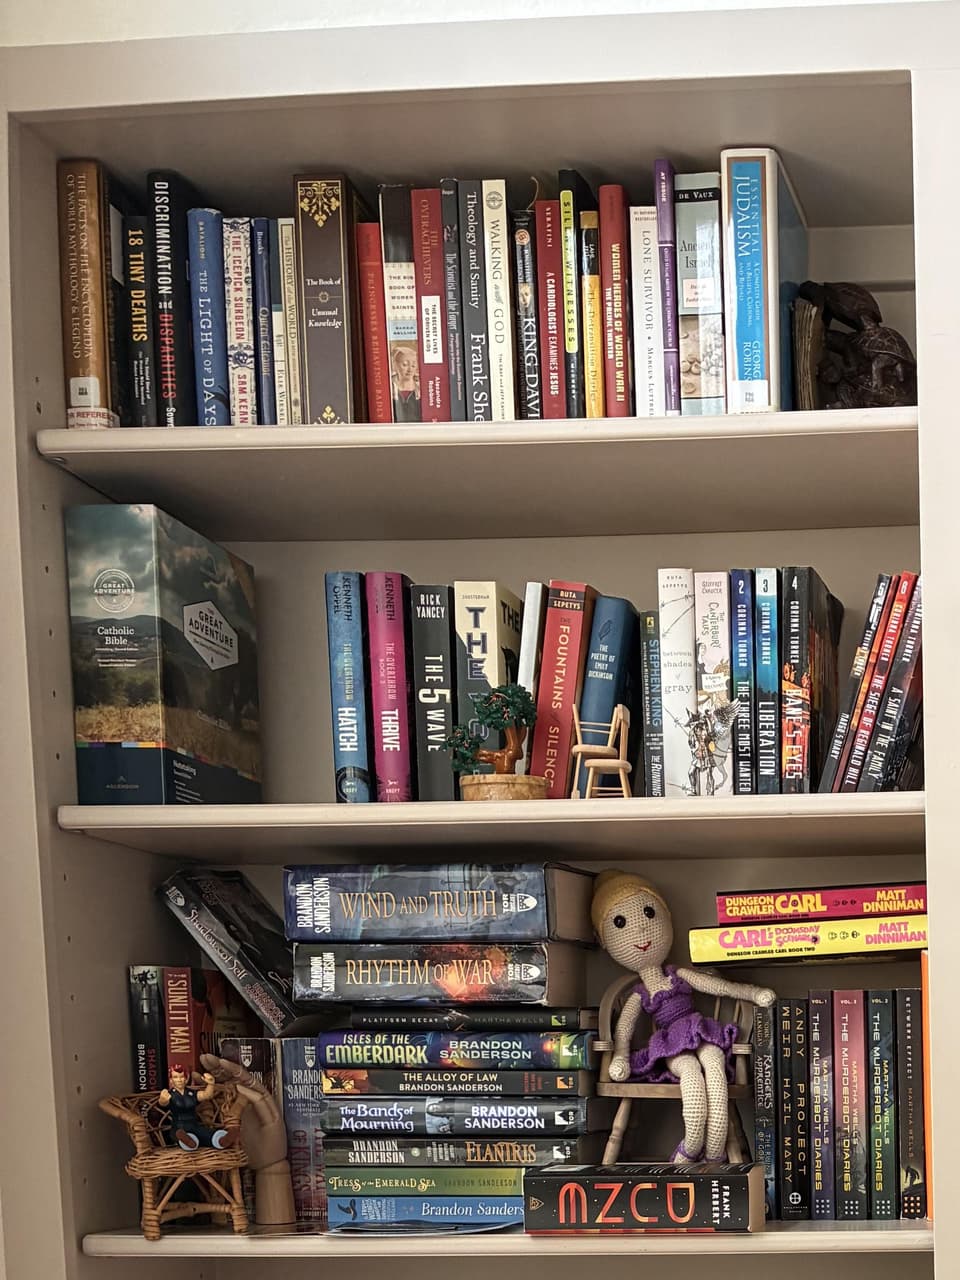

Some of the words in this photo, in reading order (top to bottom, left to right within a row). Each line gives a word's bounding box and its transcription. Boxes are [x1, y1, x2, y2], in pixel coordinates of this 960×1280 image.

[467, 192, 476, 245] Theology
[735, 176, 750, 257] JUDAISM
[129, 230, 143, 246] 18
[154, 181, 172, 294] DISCRIMINATION
[490, 220, 501, 280] WALKING
[642, 231, 651, 262] LONE
[129, 252, 144, 283] TINY
[470, 249, 479, 264] and
[611, 244, 621, 280] WOMEN
[470, 266, 480, 308] Sanity
[613, 283, 622, 318] HEROES
[645, 269, 654, 330] SURVIVOR
[130, 290, 148, 342] DEATHS
[199, 298, 212, 356] LIGHT
[494, 309, 504, 343] GOD
[614, 321, 623, 332] OF
[159, 314, 176, 399] DISPARITIES
[615, 335, 623, 368] WORLD
[204, 360, 212, 374] OF
[616, 370, 624, 392] WAR
[203, 378, 217, 426] DAYS
[763, 580, 768, 592] 3
[792, 577, 798, 589] 4
[416, 606, 445, 618] YANCEY
[420, 594, 440, 605] RICK
[554, 601, 580, 609] SEPETYS
[97, 627, 134, 635] Catholic
[760, 603, 770, 636] CORINNA
[105, 637, 128, 645] Bible
[762, 640, 770, 664] TURNER
[552, 625, 570, 708] FOUNTAINS
[649, 640, 660, 695] STEPHEN
[652, 697, 662, 727] KING
[338, 708, 358, 752] HATCH
[381, 709, 400, 752] THRIVE
[759, 702, 775, 775] LIBERATION
[786, 744, 802, 778] EYES
[297, 884, 312, 928] BRANDON
[313, 877, 331, 933] SANDERSON
[338, 892, 396, 919] WIND
[400, 897, 428, 914] AND
[429, 890, 497, 918] TRUTH
[726, 896, 774, 906] DUNGEON
[726, 905, 774, 915] CRAWLER
[776, 893, 827, 913] CARL
[863, 899, 923, 913] DINNIMAN
[877, 890, 906, 900] MATT
[346, 960, 431, 985] RHYTHM
[434, 964, 449, 982] OF
[449, 960, 495, 984] WAR
[168, 979, 189, 1023] SUNLIT
[170, 1027, 190, 1053] MAN
[343, 1035, 372, 1044] ISLES
[375, 1034, 387, 1043] OF
[391, 1034, 410, 1043] THE
[449, 1041, 522, 1049] BRANDON
[326, 1045, 428, 1064] EMBERDARK
[440, 1050, 532, 1059] SANDERSON
[424, 1073, 457, 1081] ALLOY
[477, 1073, 498, 1081] LAW
[465, 1141, 536, 1162] ELANTRIS
[711, 1180, 720, 1224] HERBERT
[722, 1185, 731, 1218] FRANK
